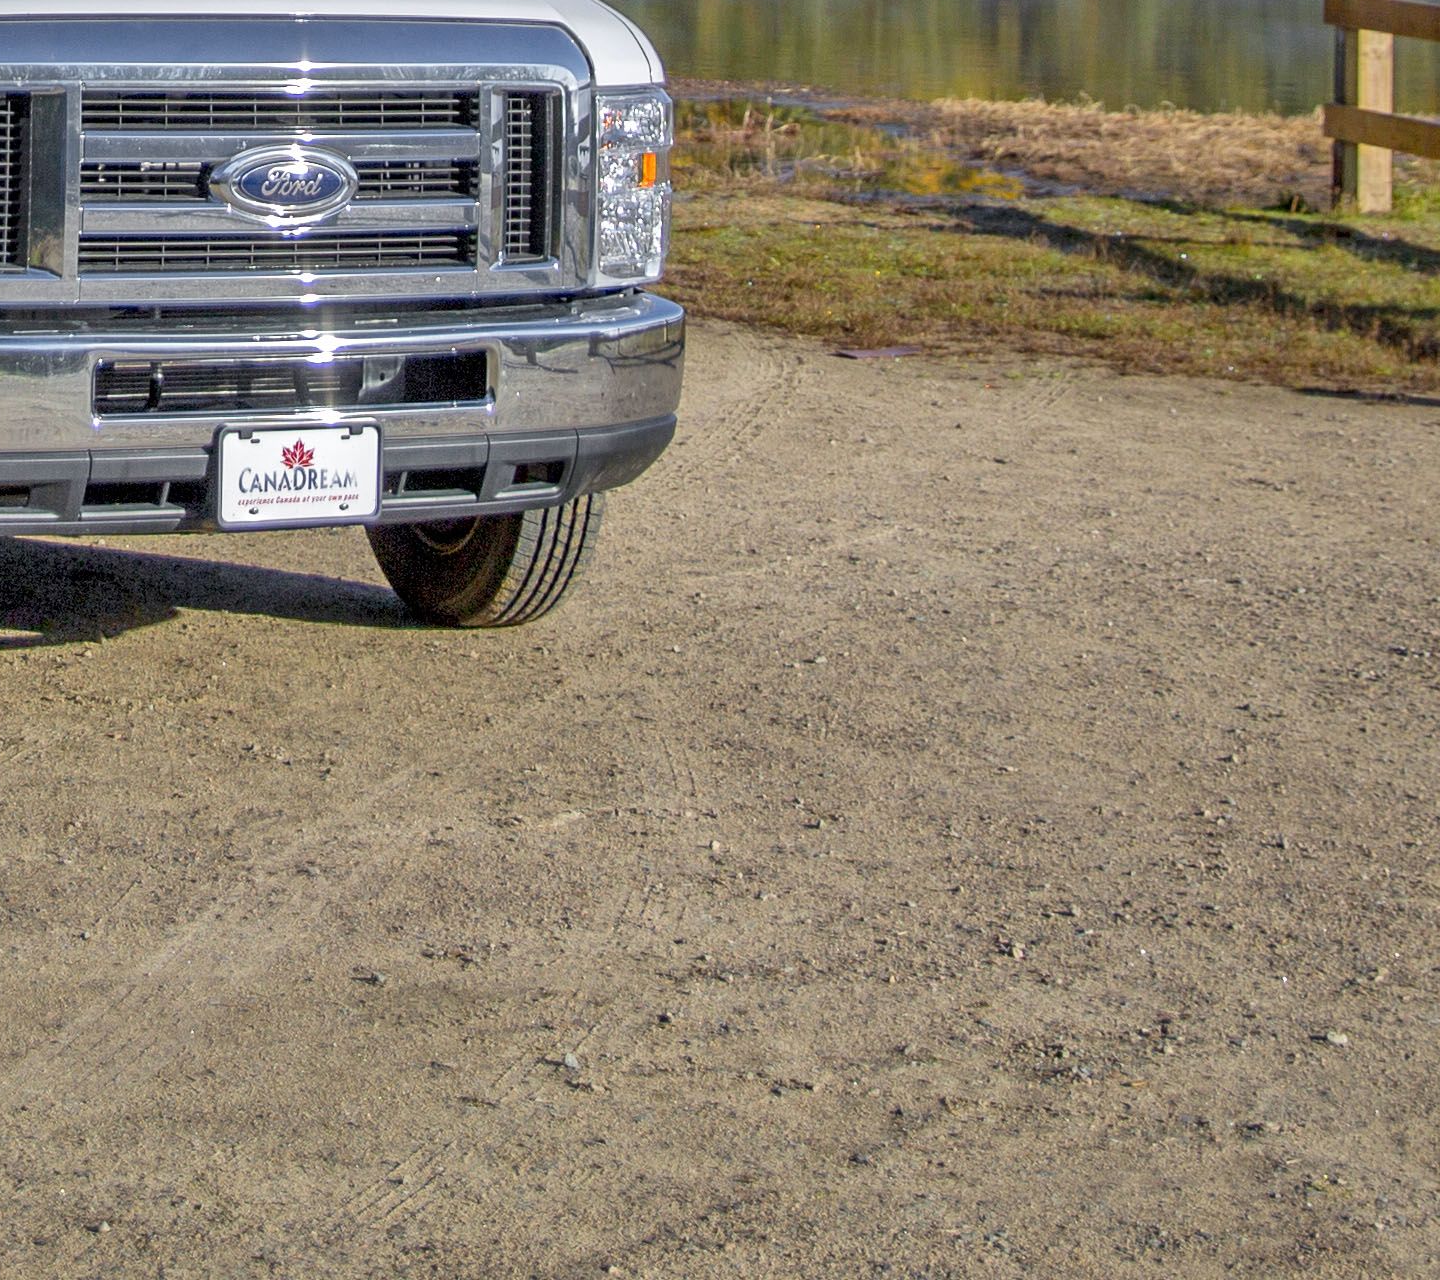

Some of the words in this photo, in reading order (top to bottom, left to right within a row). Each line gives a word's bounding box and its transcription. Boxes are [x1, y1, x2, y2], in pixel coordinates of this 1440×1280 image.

[261, 165, 324, 196] Ford
[238, 497, 275, 506] experience
[275, 495, 301, 504] Canada
[302, 494, 311, 503] at
[311, 494, 327, 503] your
[328, 493, 343, 501] own
